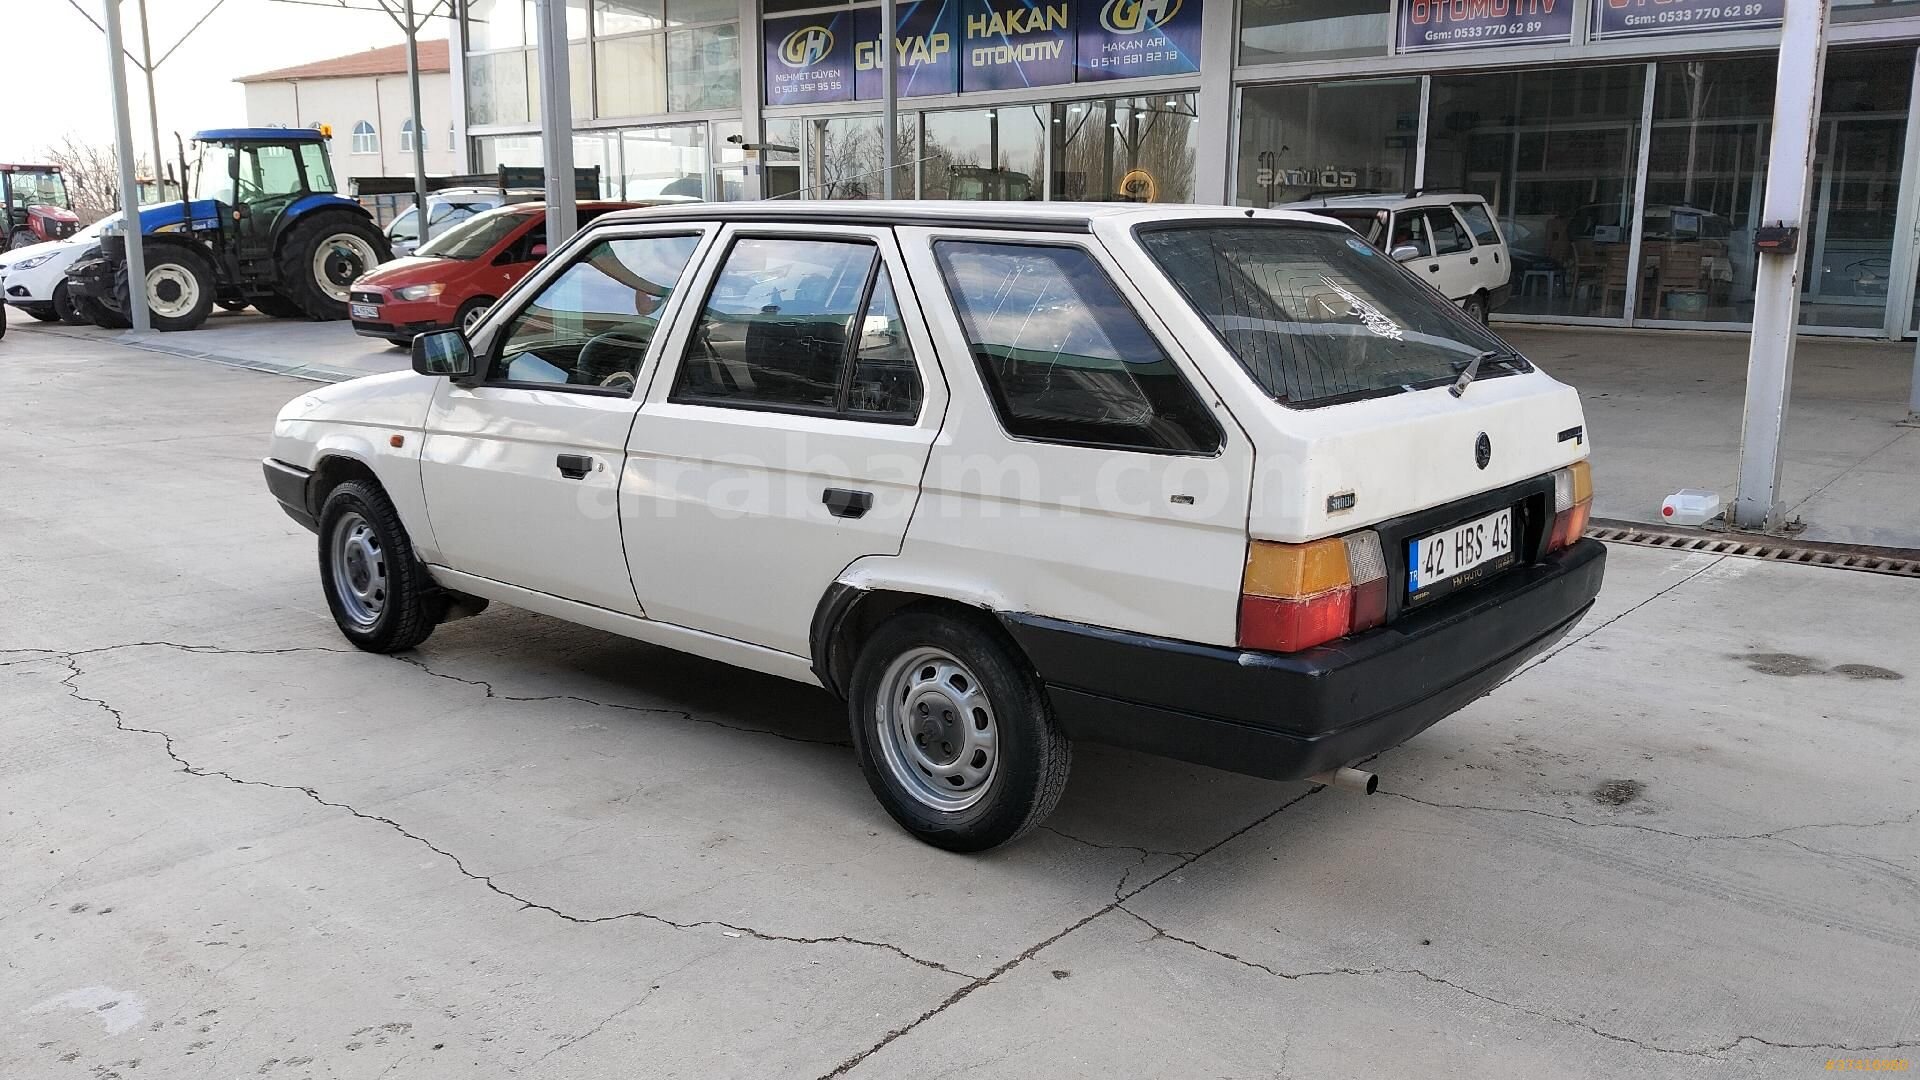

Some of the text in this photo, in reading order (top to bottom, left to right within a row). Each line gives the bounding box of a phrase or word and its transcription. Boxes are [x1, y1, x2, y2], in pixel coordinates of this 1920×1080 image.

[967, 3, 1067, 39] HAKAN
[1624, 3, 1762, 26] Gsm: 0533 770 62 89
[1425, 21, 1542, 41] Gsm: 0533 770 62 89
[1102, 37, 1166, 53] HAKAN ARI
[1091, 58, 1098, 67] 0
[1101, 56, 1120, 67] 541
[775, 69, 841, 83] MEHMET GÜVEN
[774, 86, 781, 94] 0
[1425, 514, 1509, 579] 42 HBS 43
[1409, 570, 1418, 583] TR
